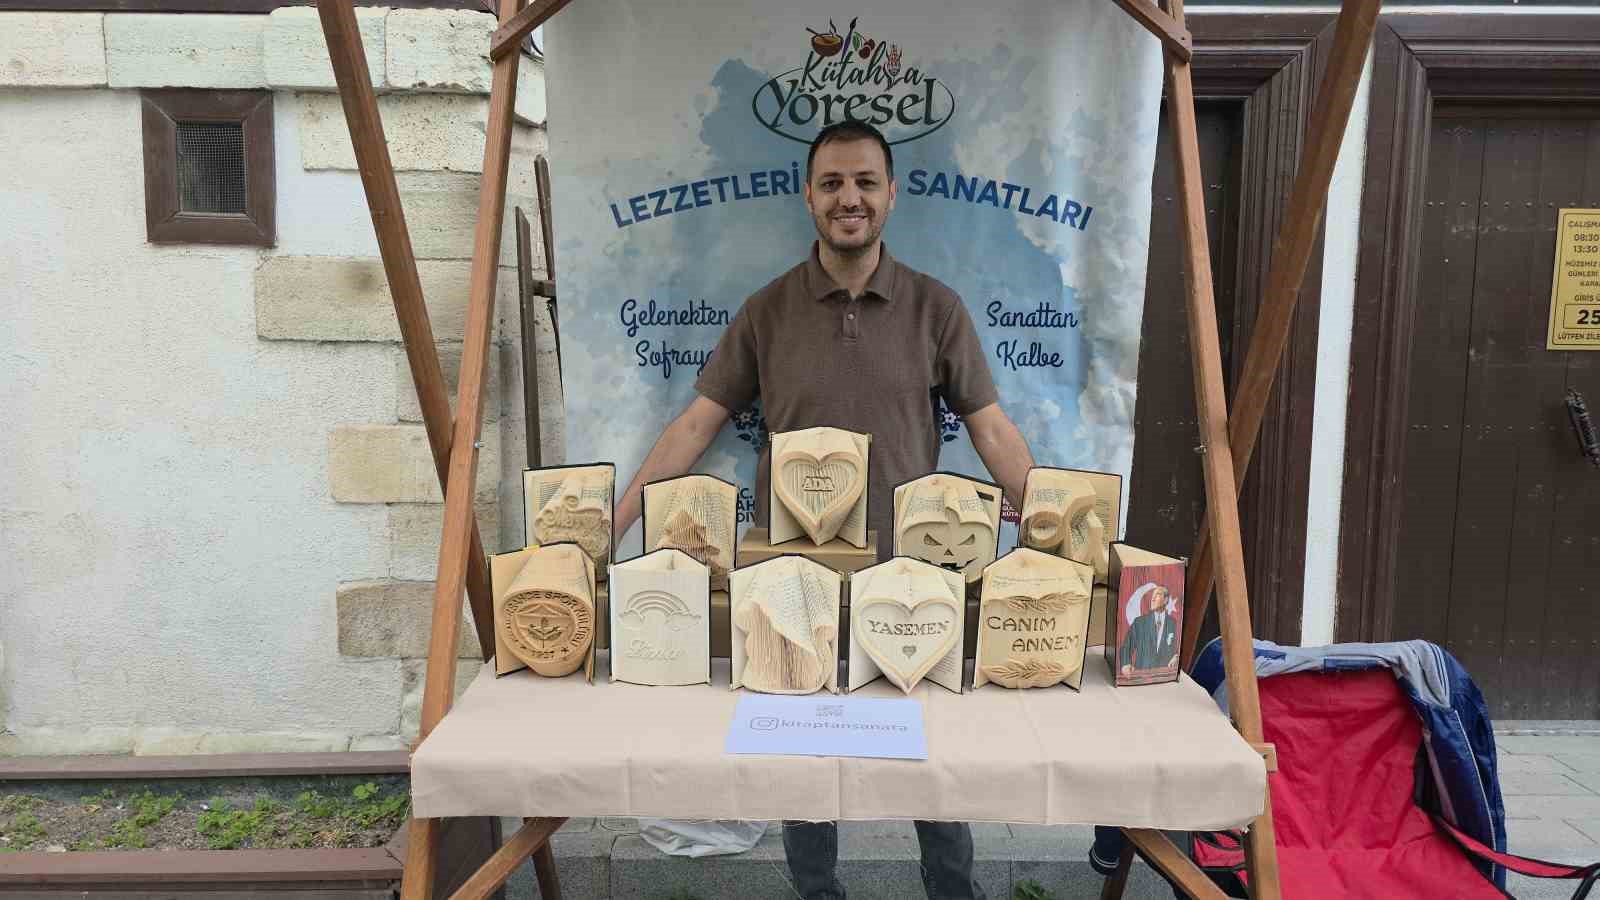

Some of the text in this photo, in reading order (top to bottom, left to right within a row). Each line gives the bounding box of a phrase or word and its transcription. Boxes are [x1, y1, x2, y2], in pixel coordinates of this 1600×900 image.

[800, 41, 925, 93] Kütahya
[766, 77, 943, 129] Yöresel
[610, 161, 1094, 231] LEZZETLERİ SANATLARI
[1573, 245, 1599, 254] 13:30
[620, 299, 729, 338] Gelenekten
[986, 300, 1078, 328] Sanattan
[996, 339, 1064, 371] Kalbe
[867, 619, 950, 636] YASEMEN
[987, 616, 1056, 632] CANIM
[1012, 634, 1079, 653] ANNEM
